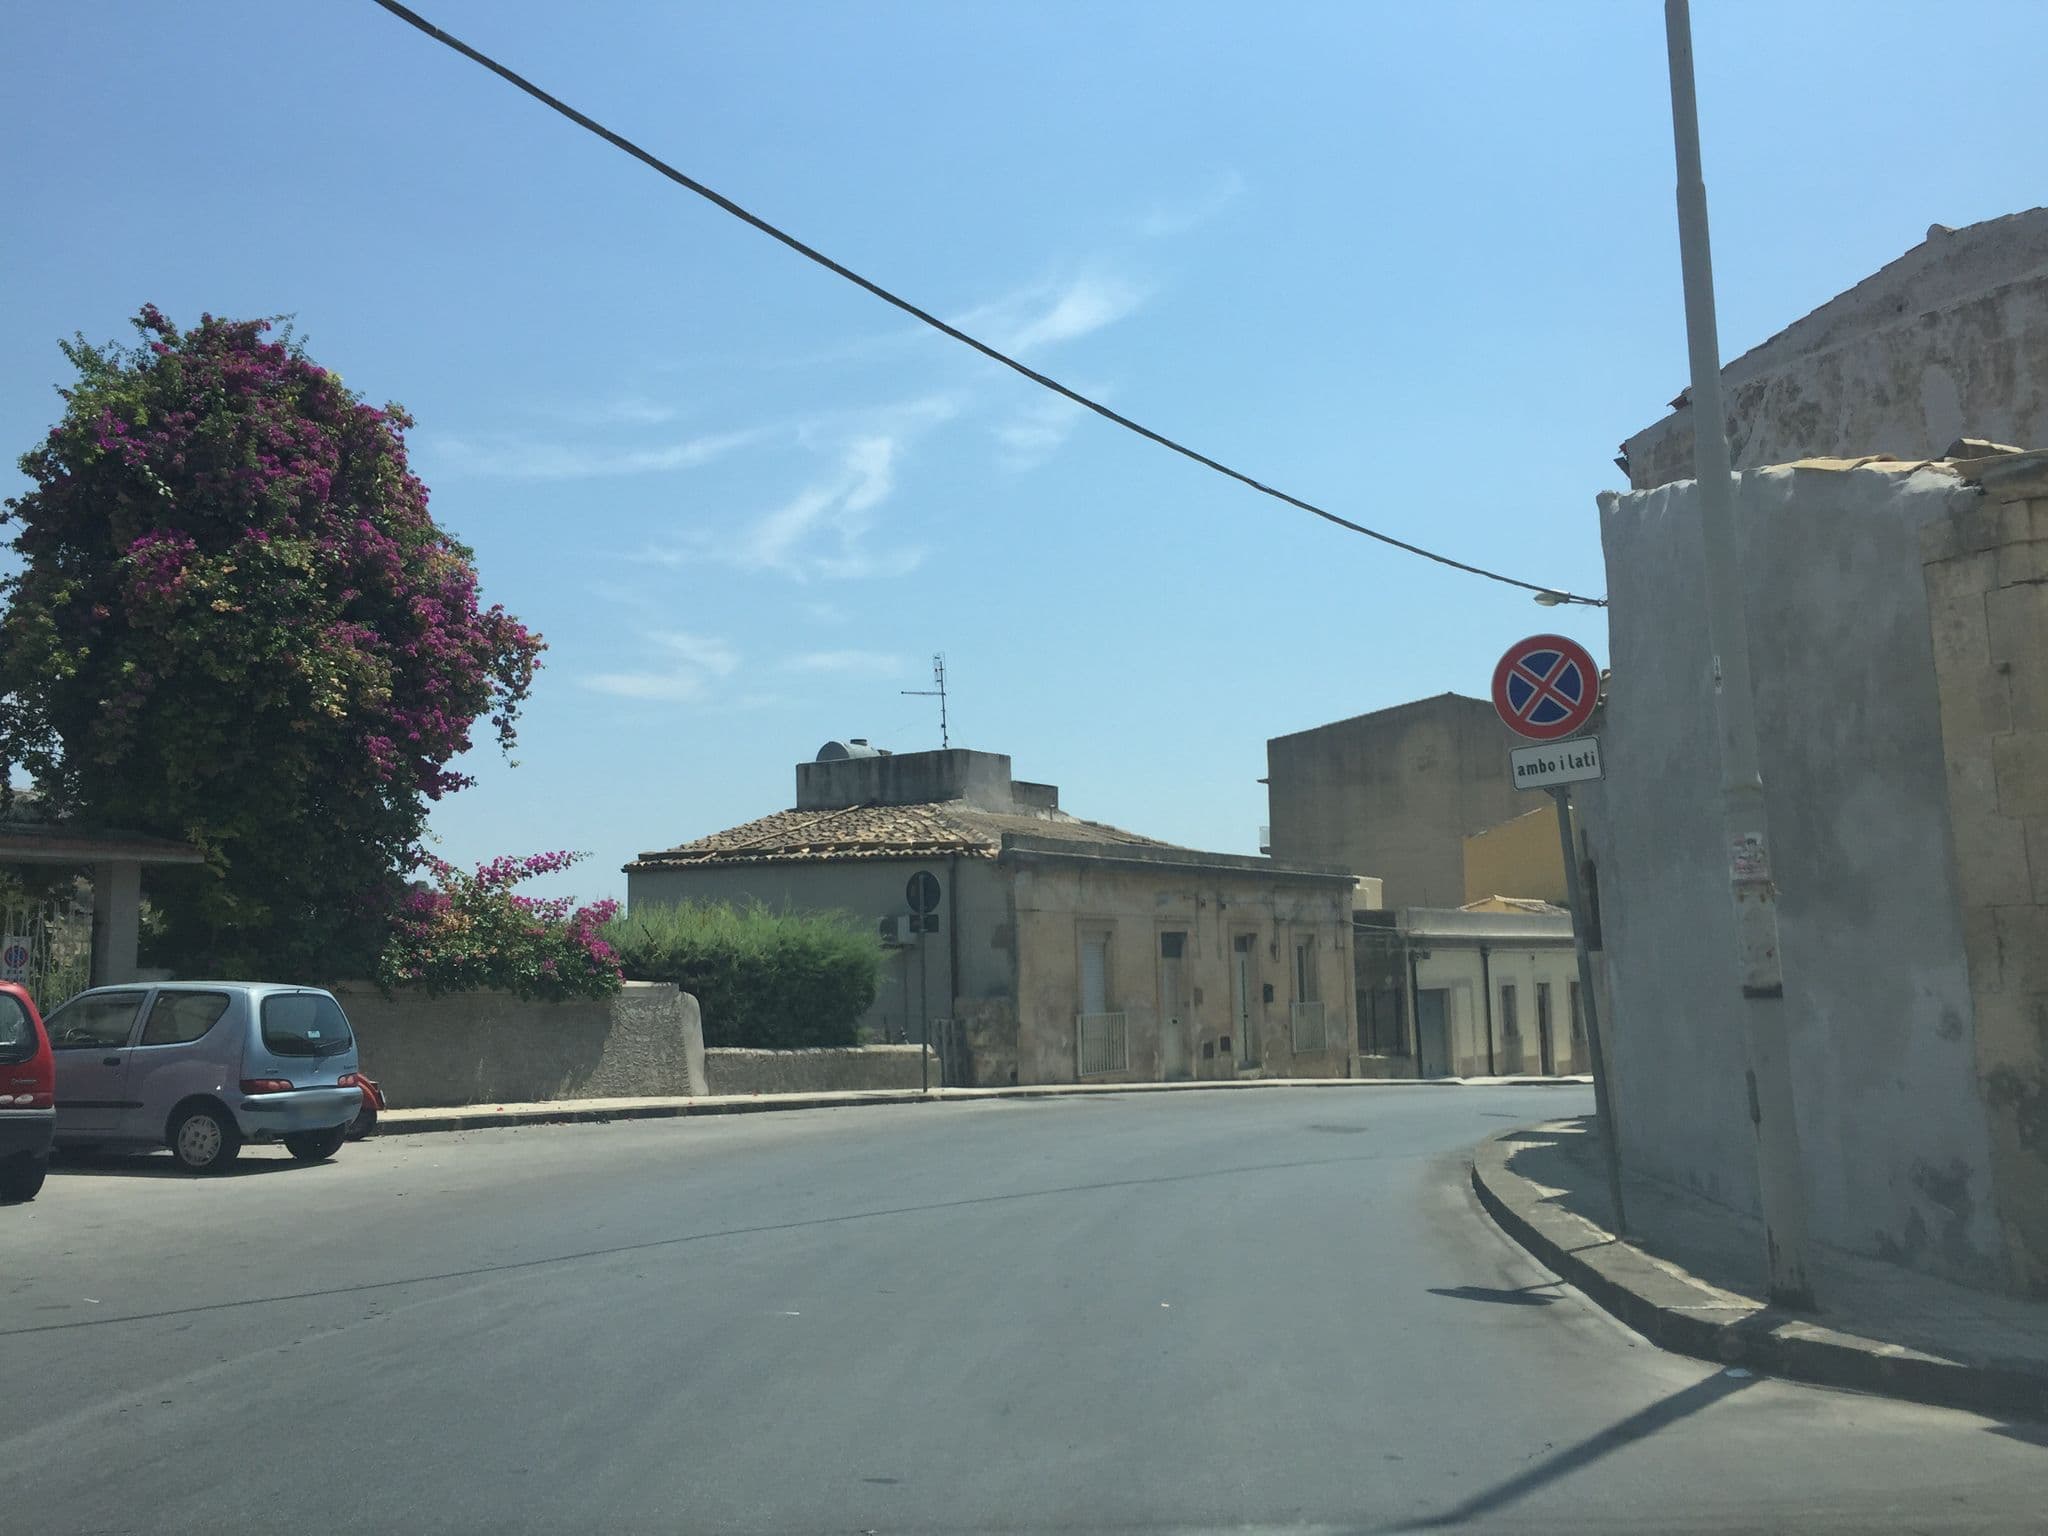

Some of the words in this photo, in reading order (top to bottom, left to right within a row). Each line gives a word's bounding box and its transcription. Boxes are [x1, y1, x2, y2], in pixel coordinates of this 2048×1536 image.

[1517, 758, 1556, 777] ambo
[1559, 755, 1565, 771] i
[1567, 751, 1596, 769] lati
